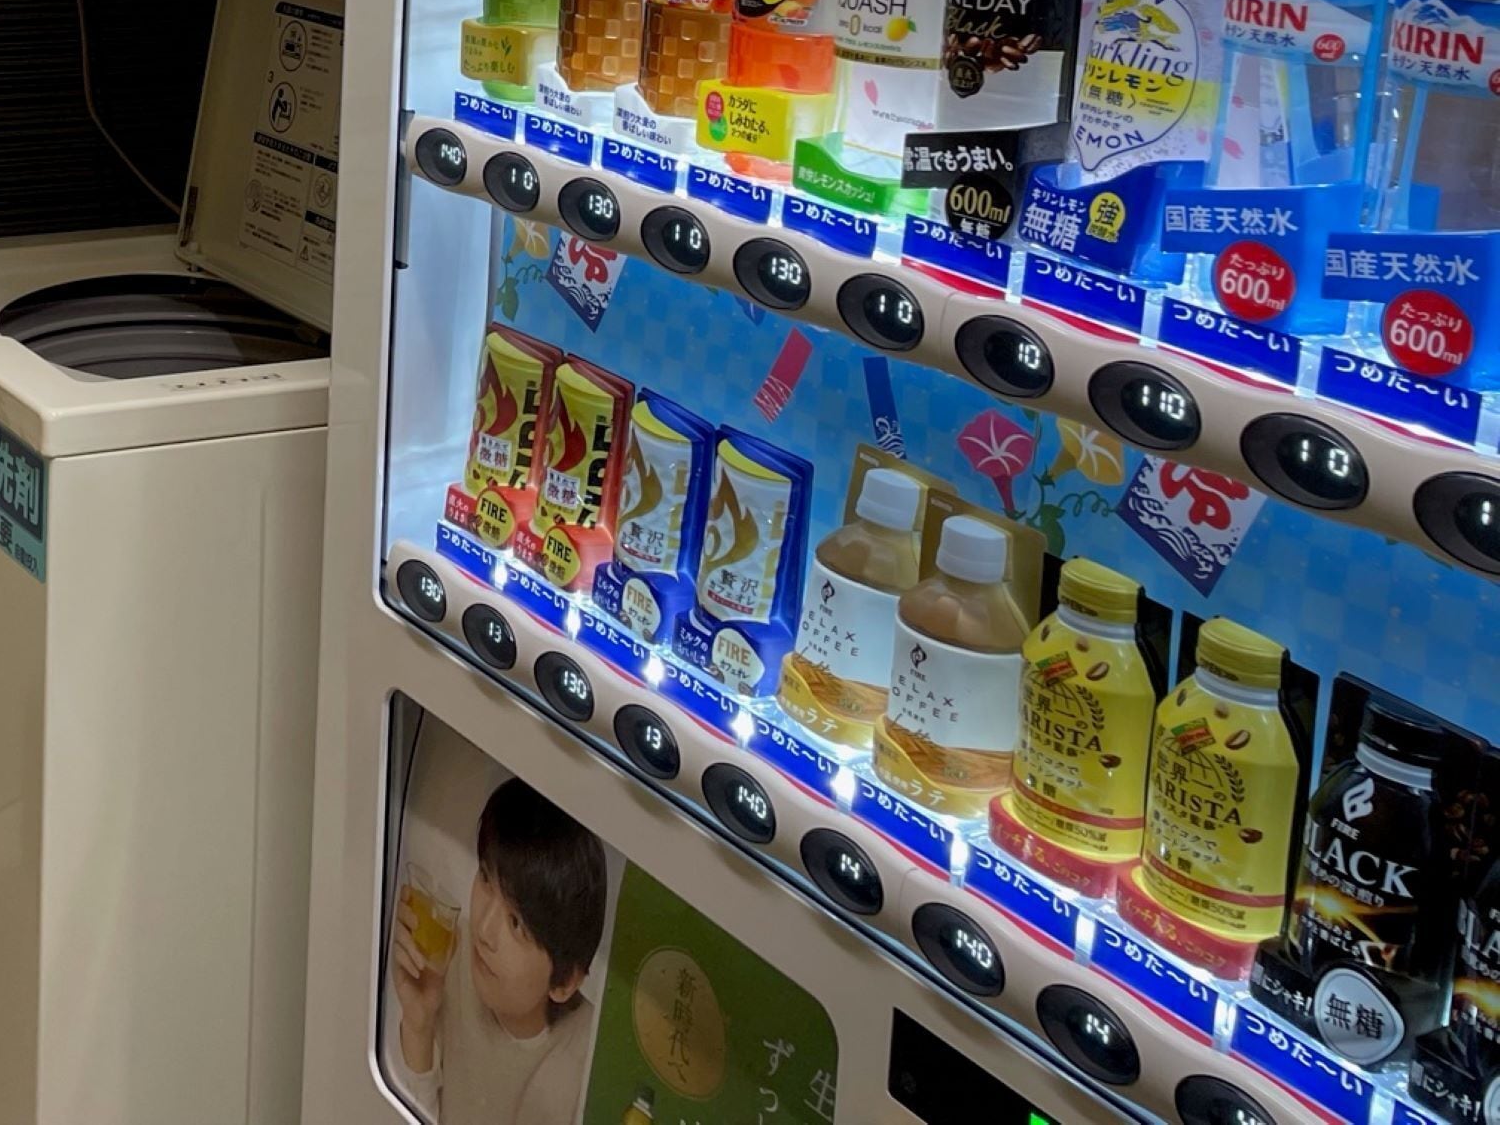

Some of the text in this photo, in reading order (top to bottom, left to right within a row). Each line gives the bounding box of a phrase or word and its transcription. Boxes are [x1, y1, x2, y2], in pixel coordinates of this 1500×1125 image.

[1249, 25, 1296, 48] 天然水
[1392, 18, 1485, 66] KIRIN
[1420, 56, 1471, 82] 天然水
[1074, 124, 1145, 150] EMON
[589, 195, 614, 219] 130
[949, 184, 1013, 225] 600ml
[1093, 198, 1121, 228] 強
[1164, 204, 1299, 237] 国産天然水
[1023, 202, 1083, 256] 無糖
[771, 258, 802, 286] 130
[1229, 252, 1287, 281] たっぷり
[1325, 248, 1481, 287] 国産天然水
[1219, 268, 1287, 313] 600ml
[1399, 300, 1464, 334] たっぷり
[1389, 320, 1464, 367] 600ml
[480, 497, 508, 524] FIRE
[546, 536, 572, 563] FIRE
[630, 522, 664, 547] 贅沢
[627, 584, 653, 615] FIRE
[720, 569, 760, 597] 贅沢
[808, 609, 856, 643] ELAX
[716, 636, 751, 666] FIRE
[563, 669, 589, 702] 130
[899, 674, 955, 708] ELAX
[737, 786, 768, 821] 140
[1154, 774, 1242, 826] ARISTA
[1330, 817, 1361, 841] FIRE
[955, 928, 994, 968] 140
[1323, 993, 1386, 1040] 無糖
